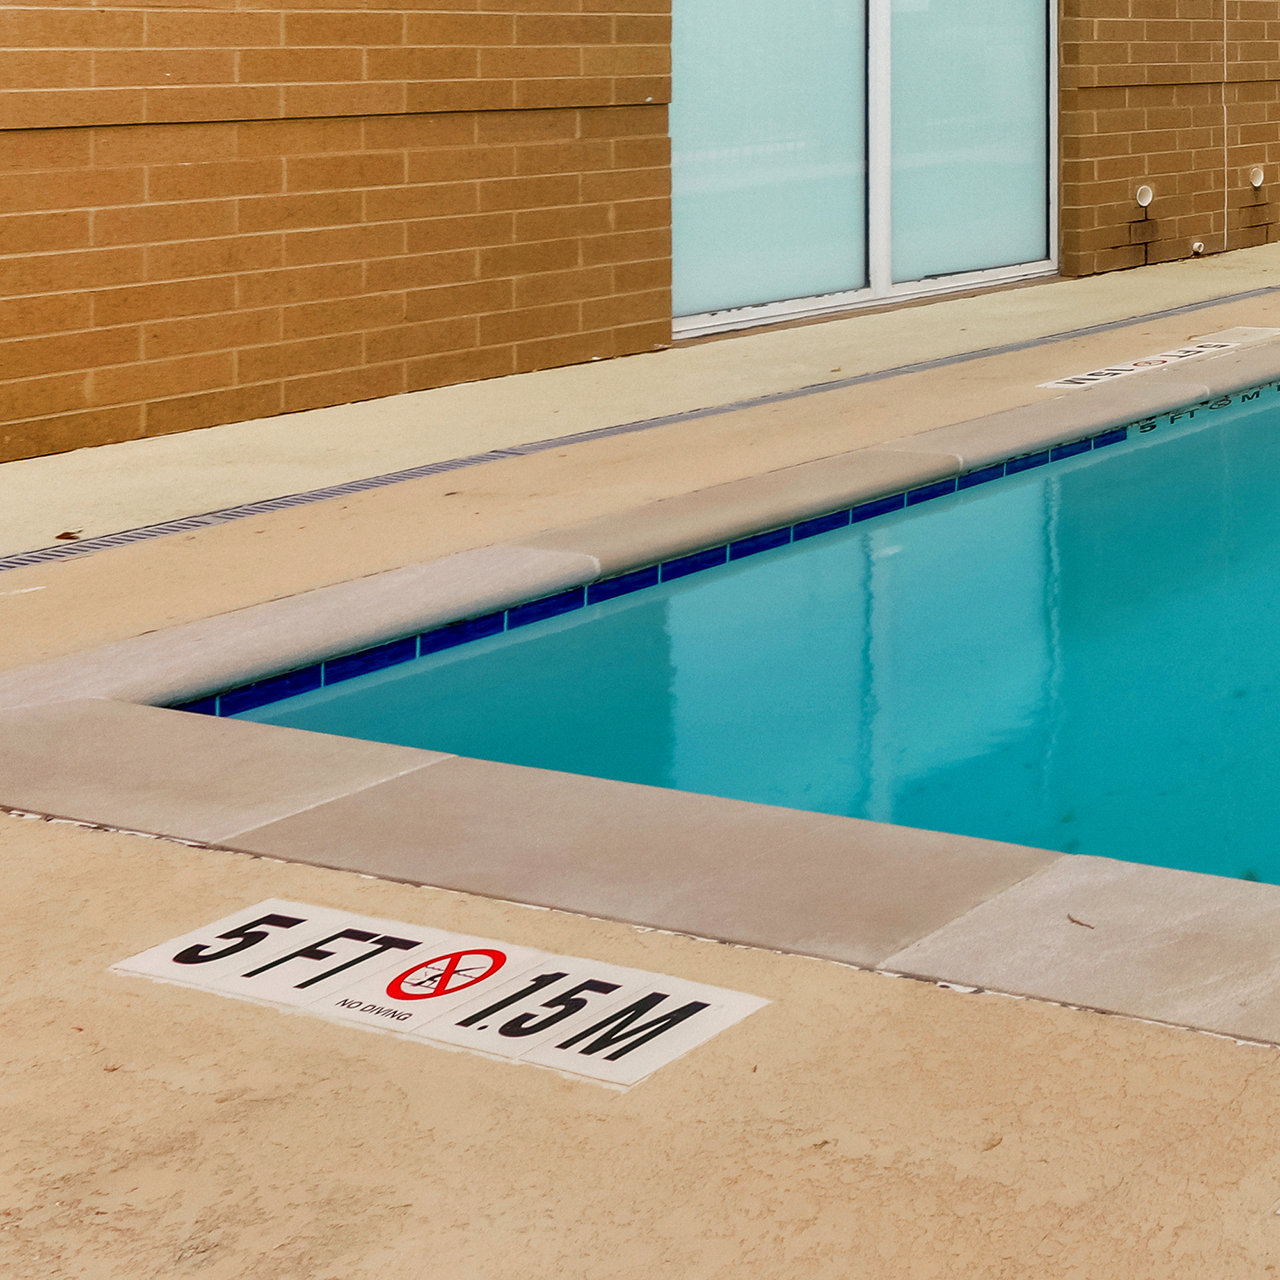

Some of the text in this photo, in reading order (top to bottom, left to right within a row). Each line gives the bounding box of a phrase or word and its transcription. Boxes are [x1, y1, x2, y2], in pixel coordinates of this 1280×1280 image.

[1139, 421, 1157, 433] 5
[1170, 408, 1200, 424] FT
[1241, 390, 1260, 403] M
[172, 913, 711, 1061] 5 FT 1.5 M
[335, 998, 413, 1021] NO DIVING
